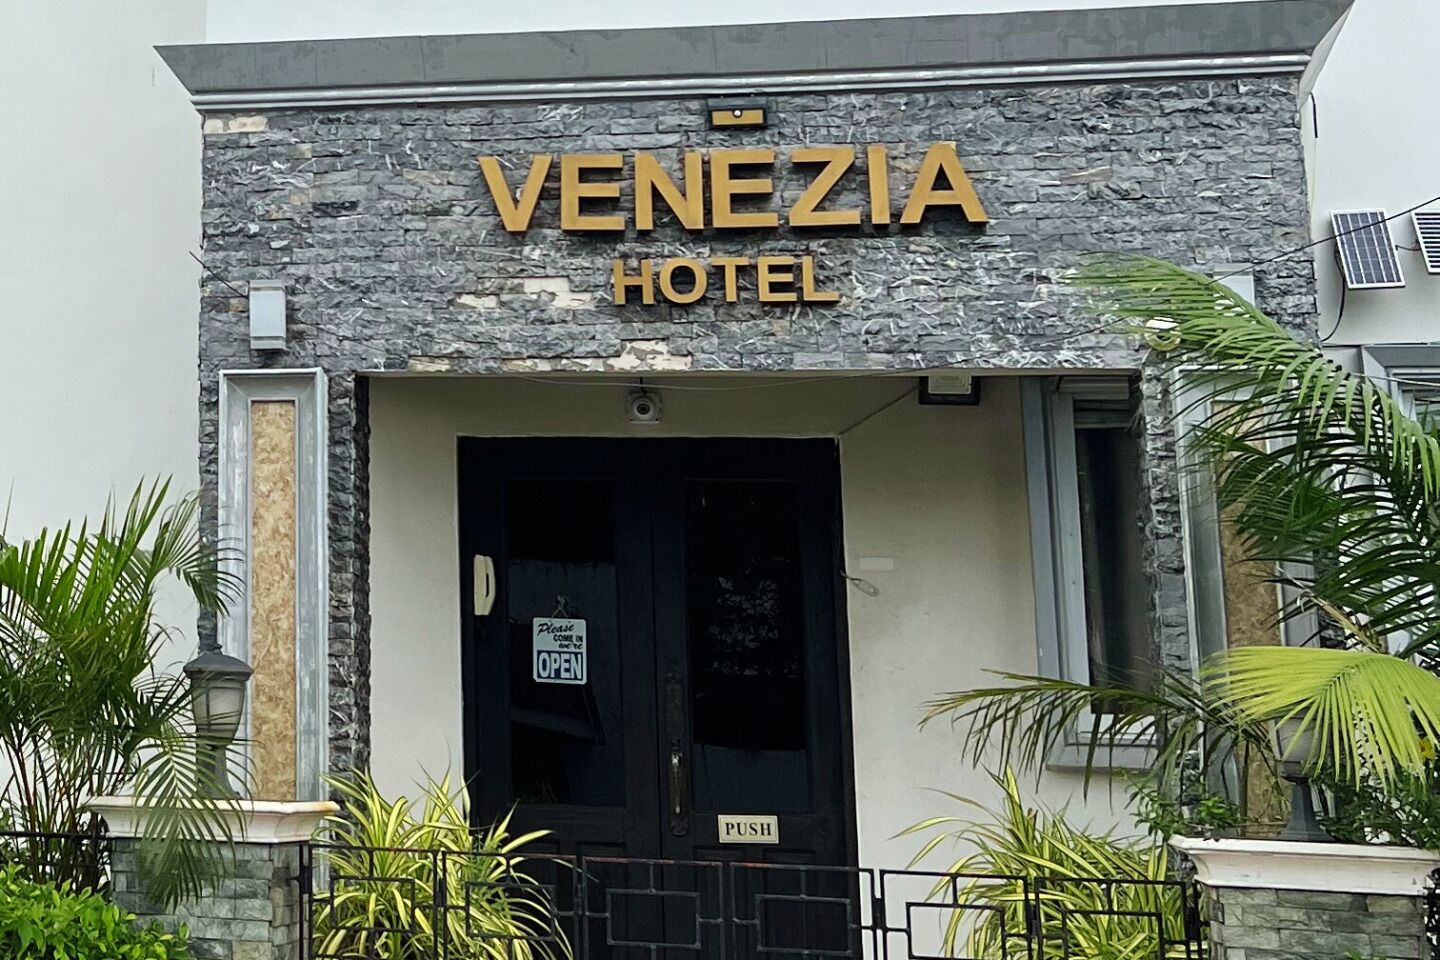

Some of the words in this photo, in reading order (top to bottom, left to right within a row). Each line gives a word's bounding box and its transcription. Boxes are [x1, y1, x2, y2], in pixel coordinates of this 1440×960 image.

[478, 141, 988, 232] VENEZIA
[613, 255, 841, 305] HOTEL
[537, 623, 574, 636] Please
[553, 634, 573, 642] COME
[575, 635, 583, 643] IN
[538, 652, 582, 679] OPEN
[725, 822, 771, 836] PUSH
